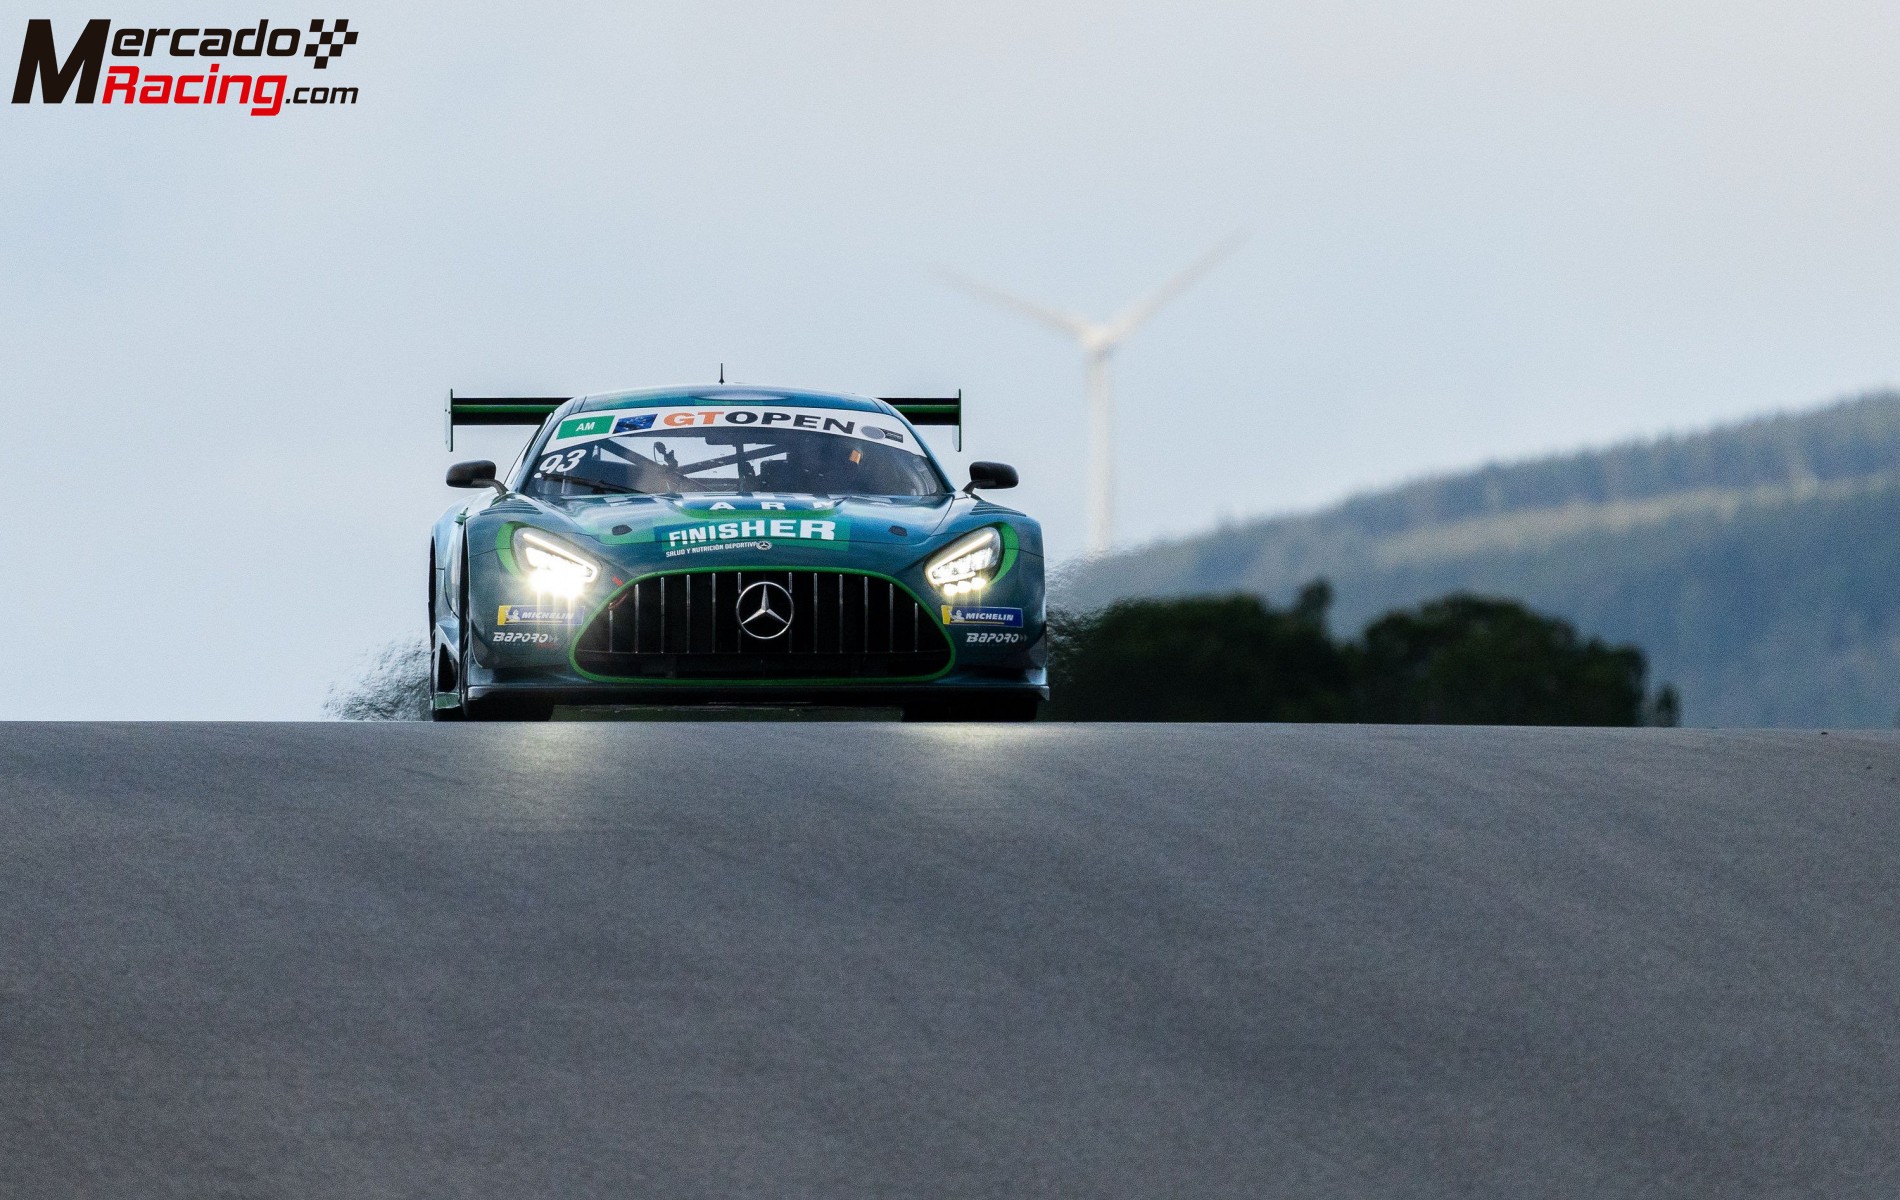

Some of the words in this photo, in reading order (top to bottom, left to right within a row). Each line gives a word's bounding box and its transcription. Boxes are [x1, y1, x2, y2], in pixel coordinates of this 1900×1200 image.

[576, 421, 596, 432] AM
[539, 449, 587, 474] 93
[668, 519, 836, 547] FINISHER
[665, 549, 686, 558] SALUD
[521, 611, 575, 620] MICHELIN
[965, 612, 1014, 621] MICHELIN
